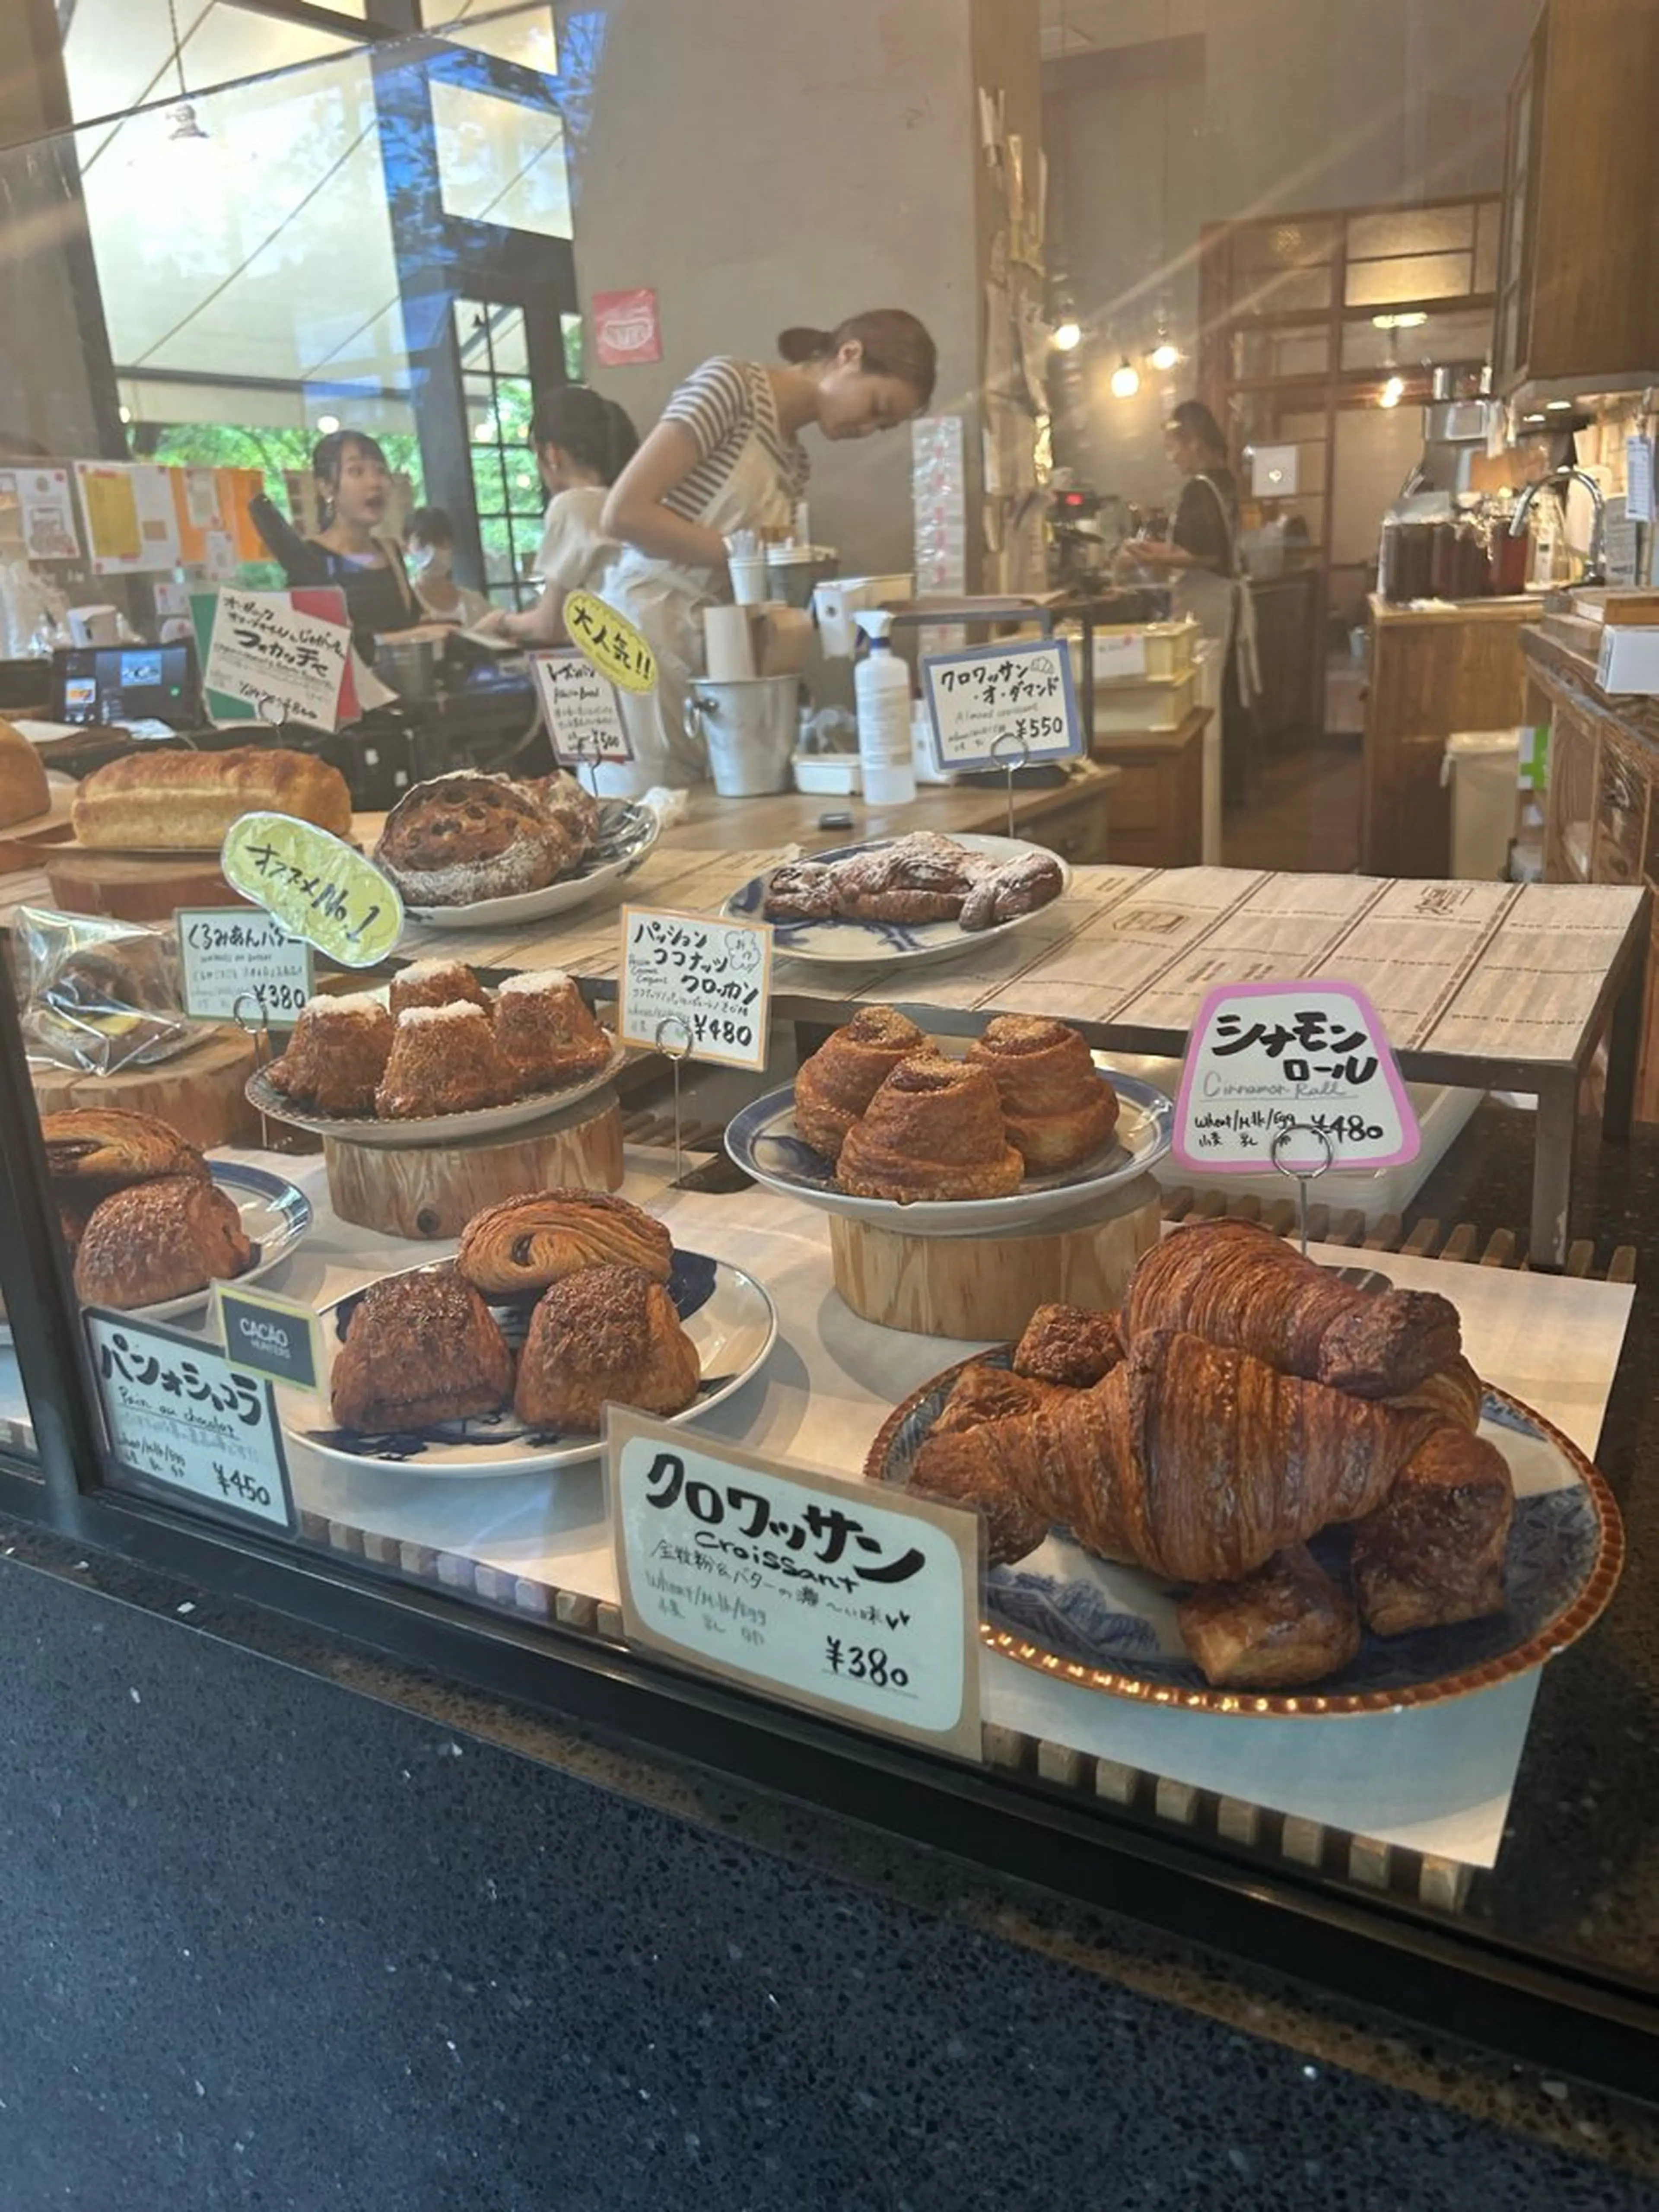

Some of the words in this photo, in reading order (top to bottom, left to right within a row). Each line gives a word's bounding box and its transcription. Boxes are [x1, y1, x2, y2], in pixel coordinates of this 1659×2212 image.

[941, 660, 1029, 693] クロワッサン
[1015, 715, 1064, 739] ¥550
[634, 920, 708, 949] パッション
[653, 947, 729, 974] ココナッツ
[252, 983, 306, 1011] ¥380
[693, 1013, 753, 1047] ¥480
[1211, 1011, 1368, 1057] シナモン
[1283, 1055, 1379, 1084] ロール
[1311, 1113, 1384, 1144] ¥480
[213, 1460, 271, 1506] ¥450
[645, 1452, 925, 1583] クロワッサン
[826, 1635, 909, 1688] ¥380
